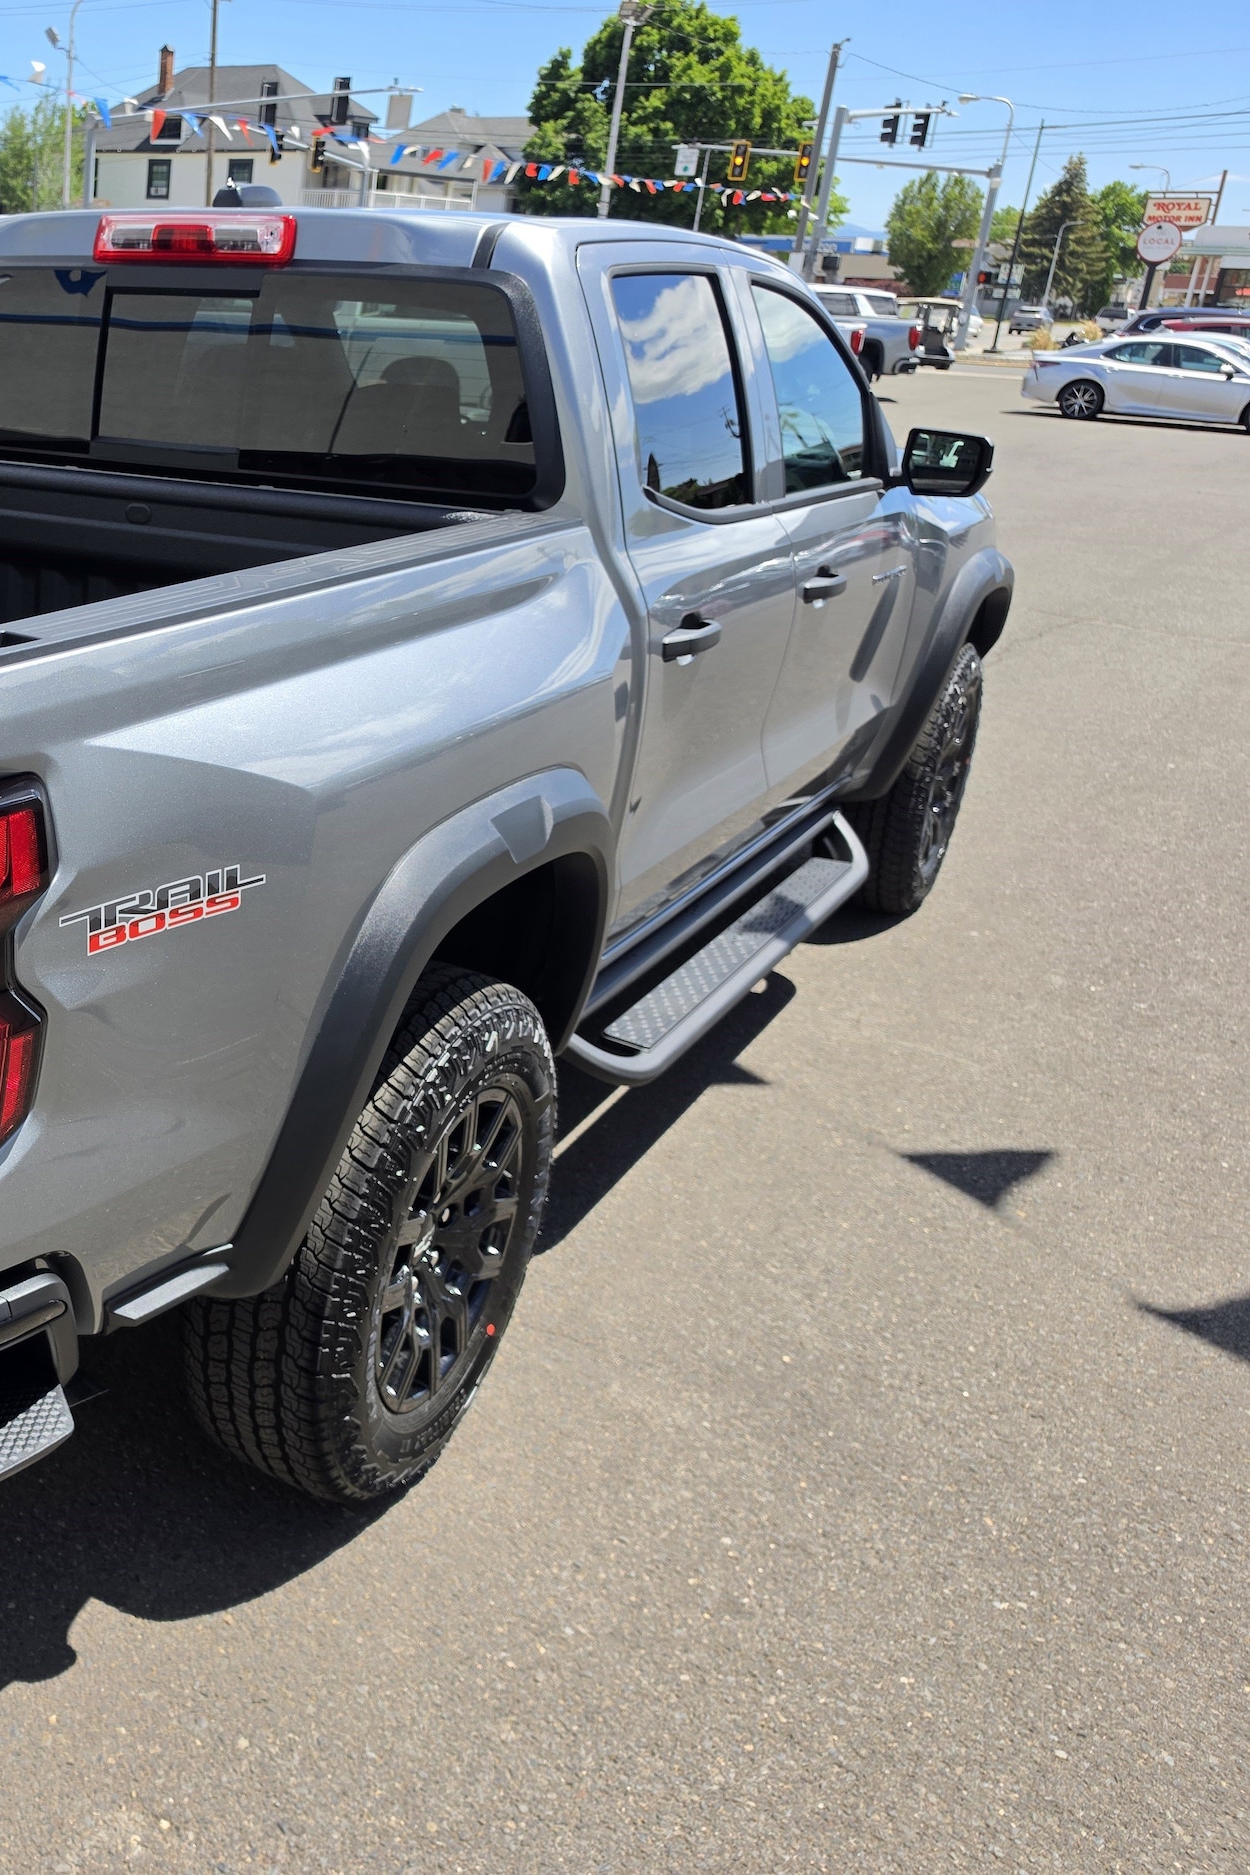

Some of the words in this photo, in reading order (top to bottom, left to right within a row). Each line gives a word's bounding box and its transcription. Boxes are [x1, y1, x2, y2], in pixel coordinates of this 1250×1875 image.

[1153, 202, 1201, 213] ROYAL
[59, 864, 266, 933] TRAIL
[87, 889, 241, 956] BOSS
